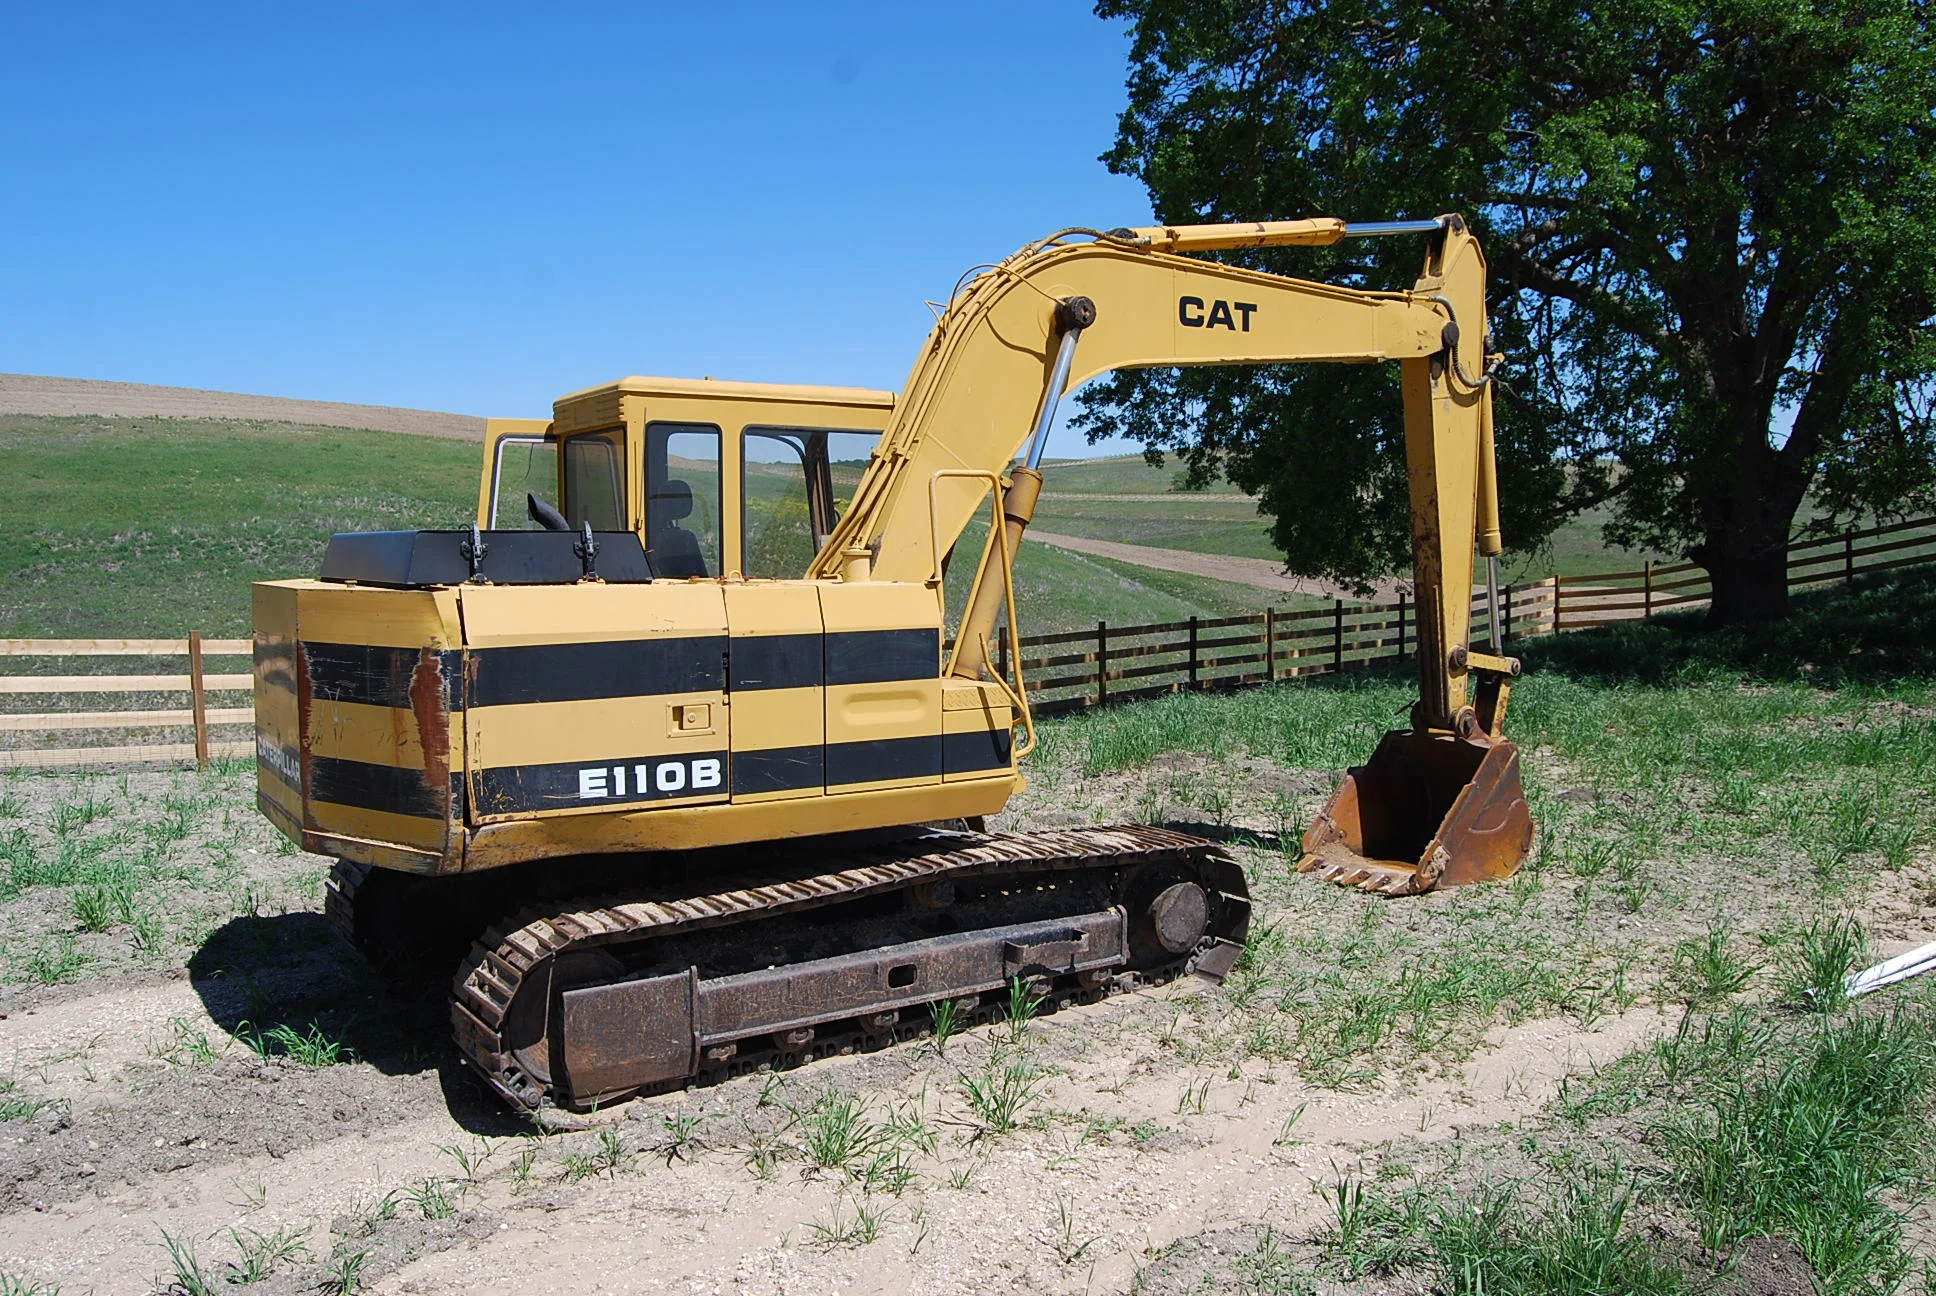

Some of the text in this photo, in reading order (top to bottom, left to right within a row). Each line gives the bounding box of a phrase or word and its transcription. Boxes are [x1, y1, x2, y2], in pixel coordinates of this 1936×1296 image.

[1179, 296, 1257, 332] CAT
[257, 735, 301, 784] CATERPILLAR
[579, 759, 721, 799] E110B
